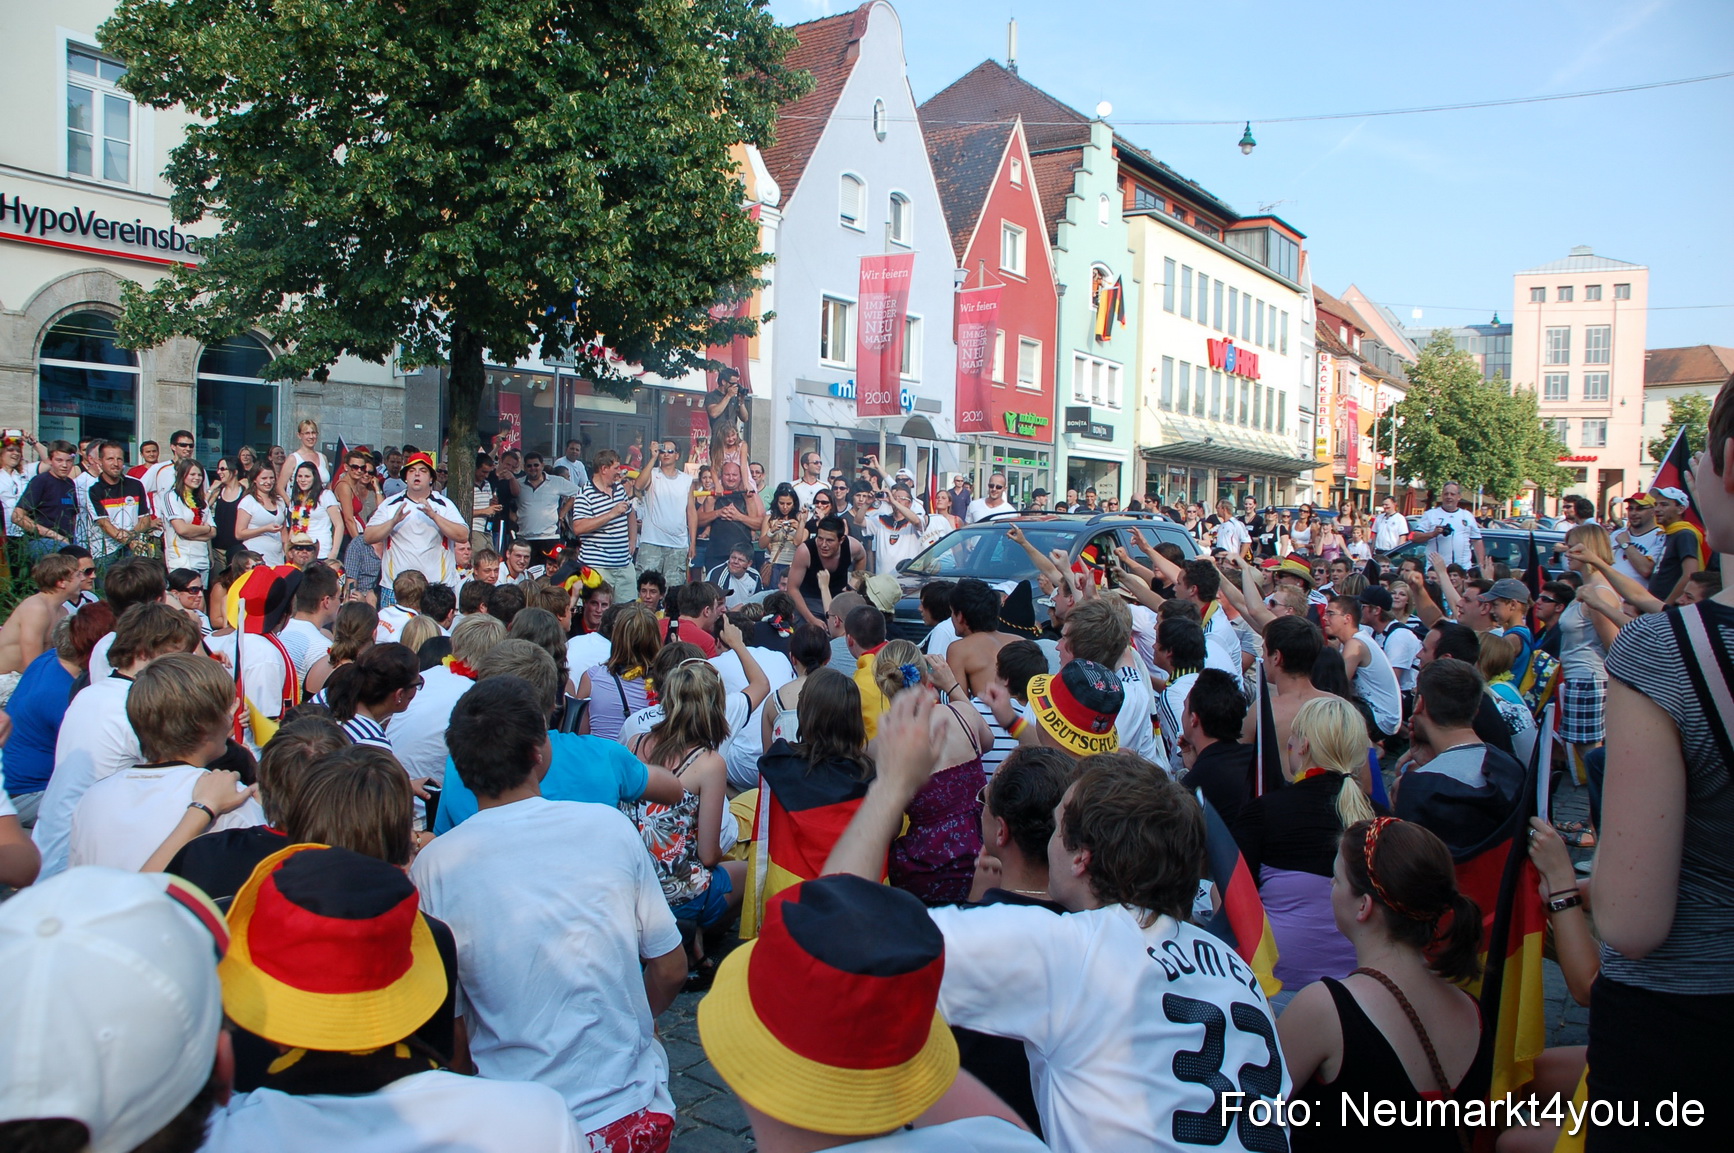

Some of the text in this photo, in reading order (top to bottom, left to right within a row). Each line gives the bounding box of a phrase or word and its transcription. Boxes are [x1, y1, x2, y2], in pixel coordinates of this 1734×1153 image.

[0, 193, 220, 256] HypoVereinsba
[861, 268, 909, 280] Wir feiern
[960, 303, 975, 313] Wir
[864, 320, 893, 334] NEU
[864, 391, 891, 404] 2010
[962, 410, 983, 422] 2010
[1067, 419, 1087, 428] BONITA
